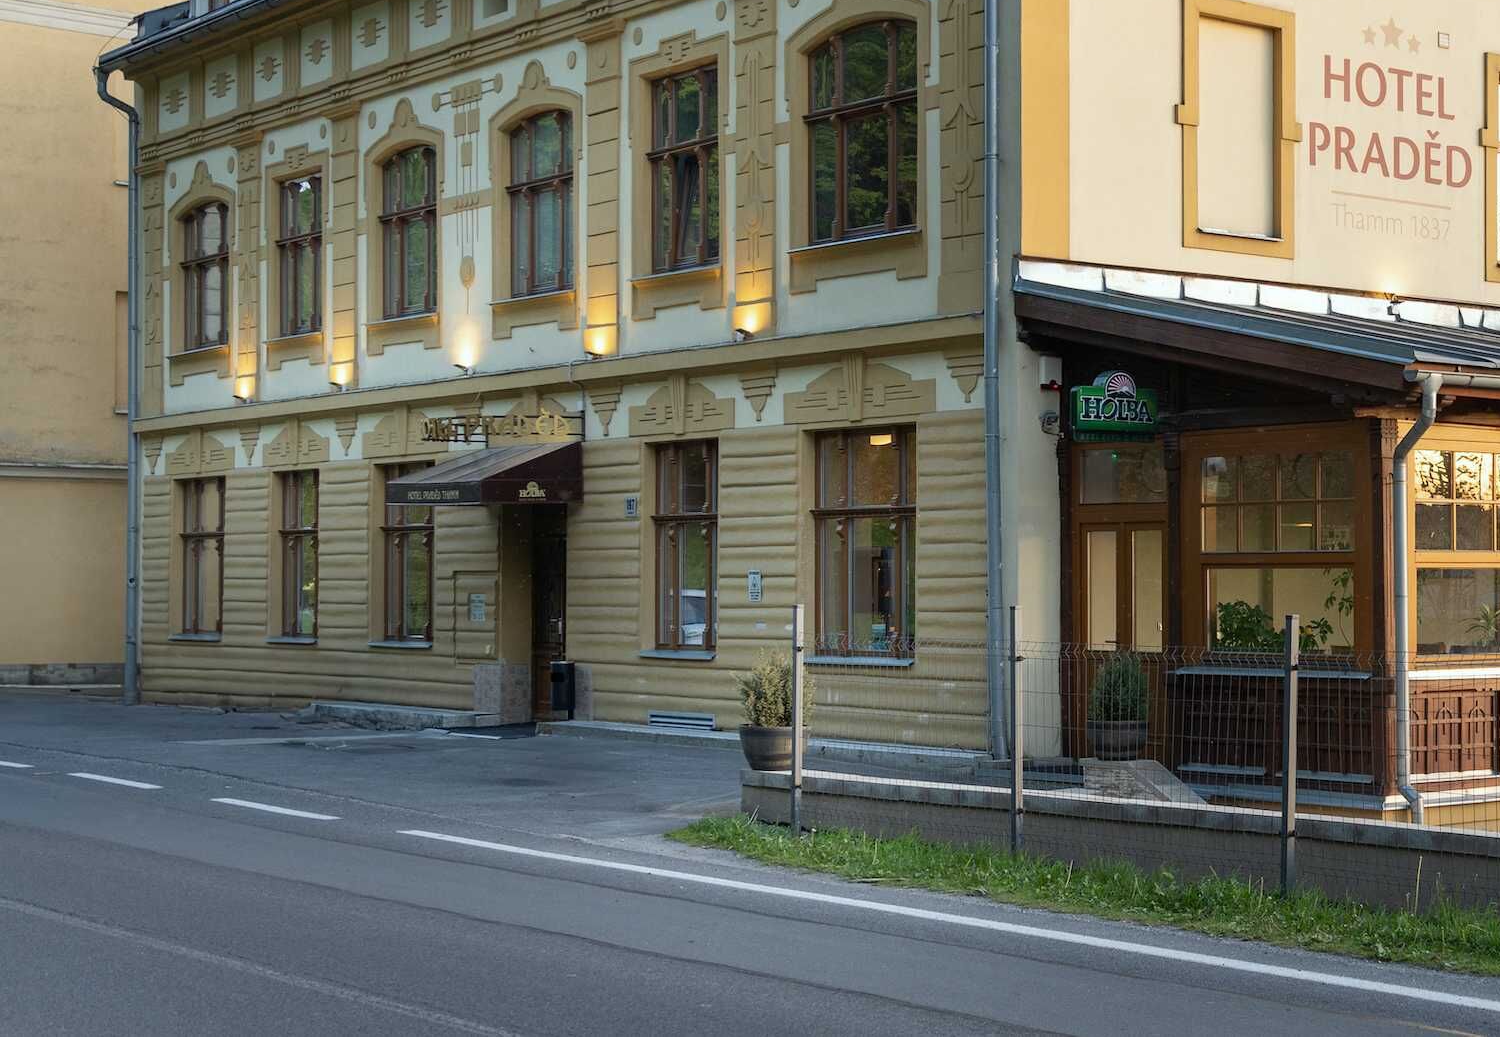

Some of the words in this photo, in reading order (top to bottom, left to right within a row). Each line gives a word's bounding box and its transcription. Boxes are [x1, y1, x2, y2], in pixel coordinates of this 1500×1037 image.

[1323, 54, 1456, 121] HOTEL
[1308, 121, 1473, 189] PRADĚD
[1330, 202, 1403, 236] Thamm
[1410, 215, 1451, 241] 1837
[1080, 395, 1154, 424] HOLBA
